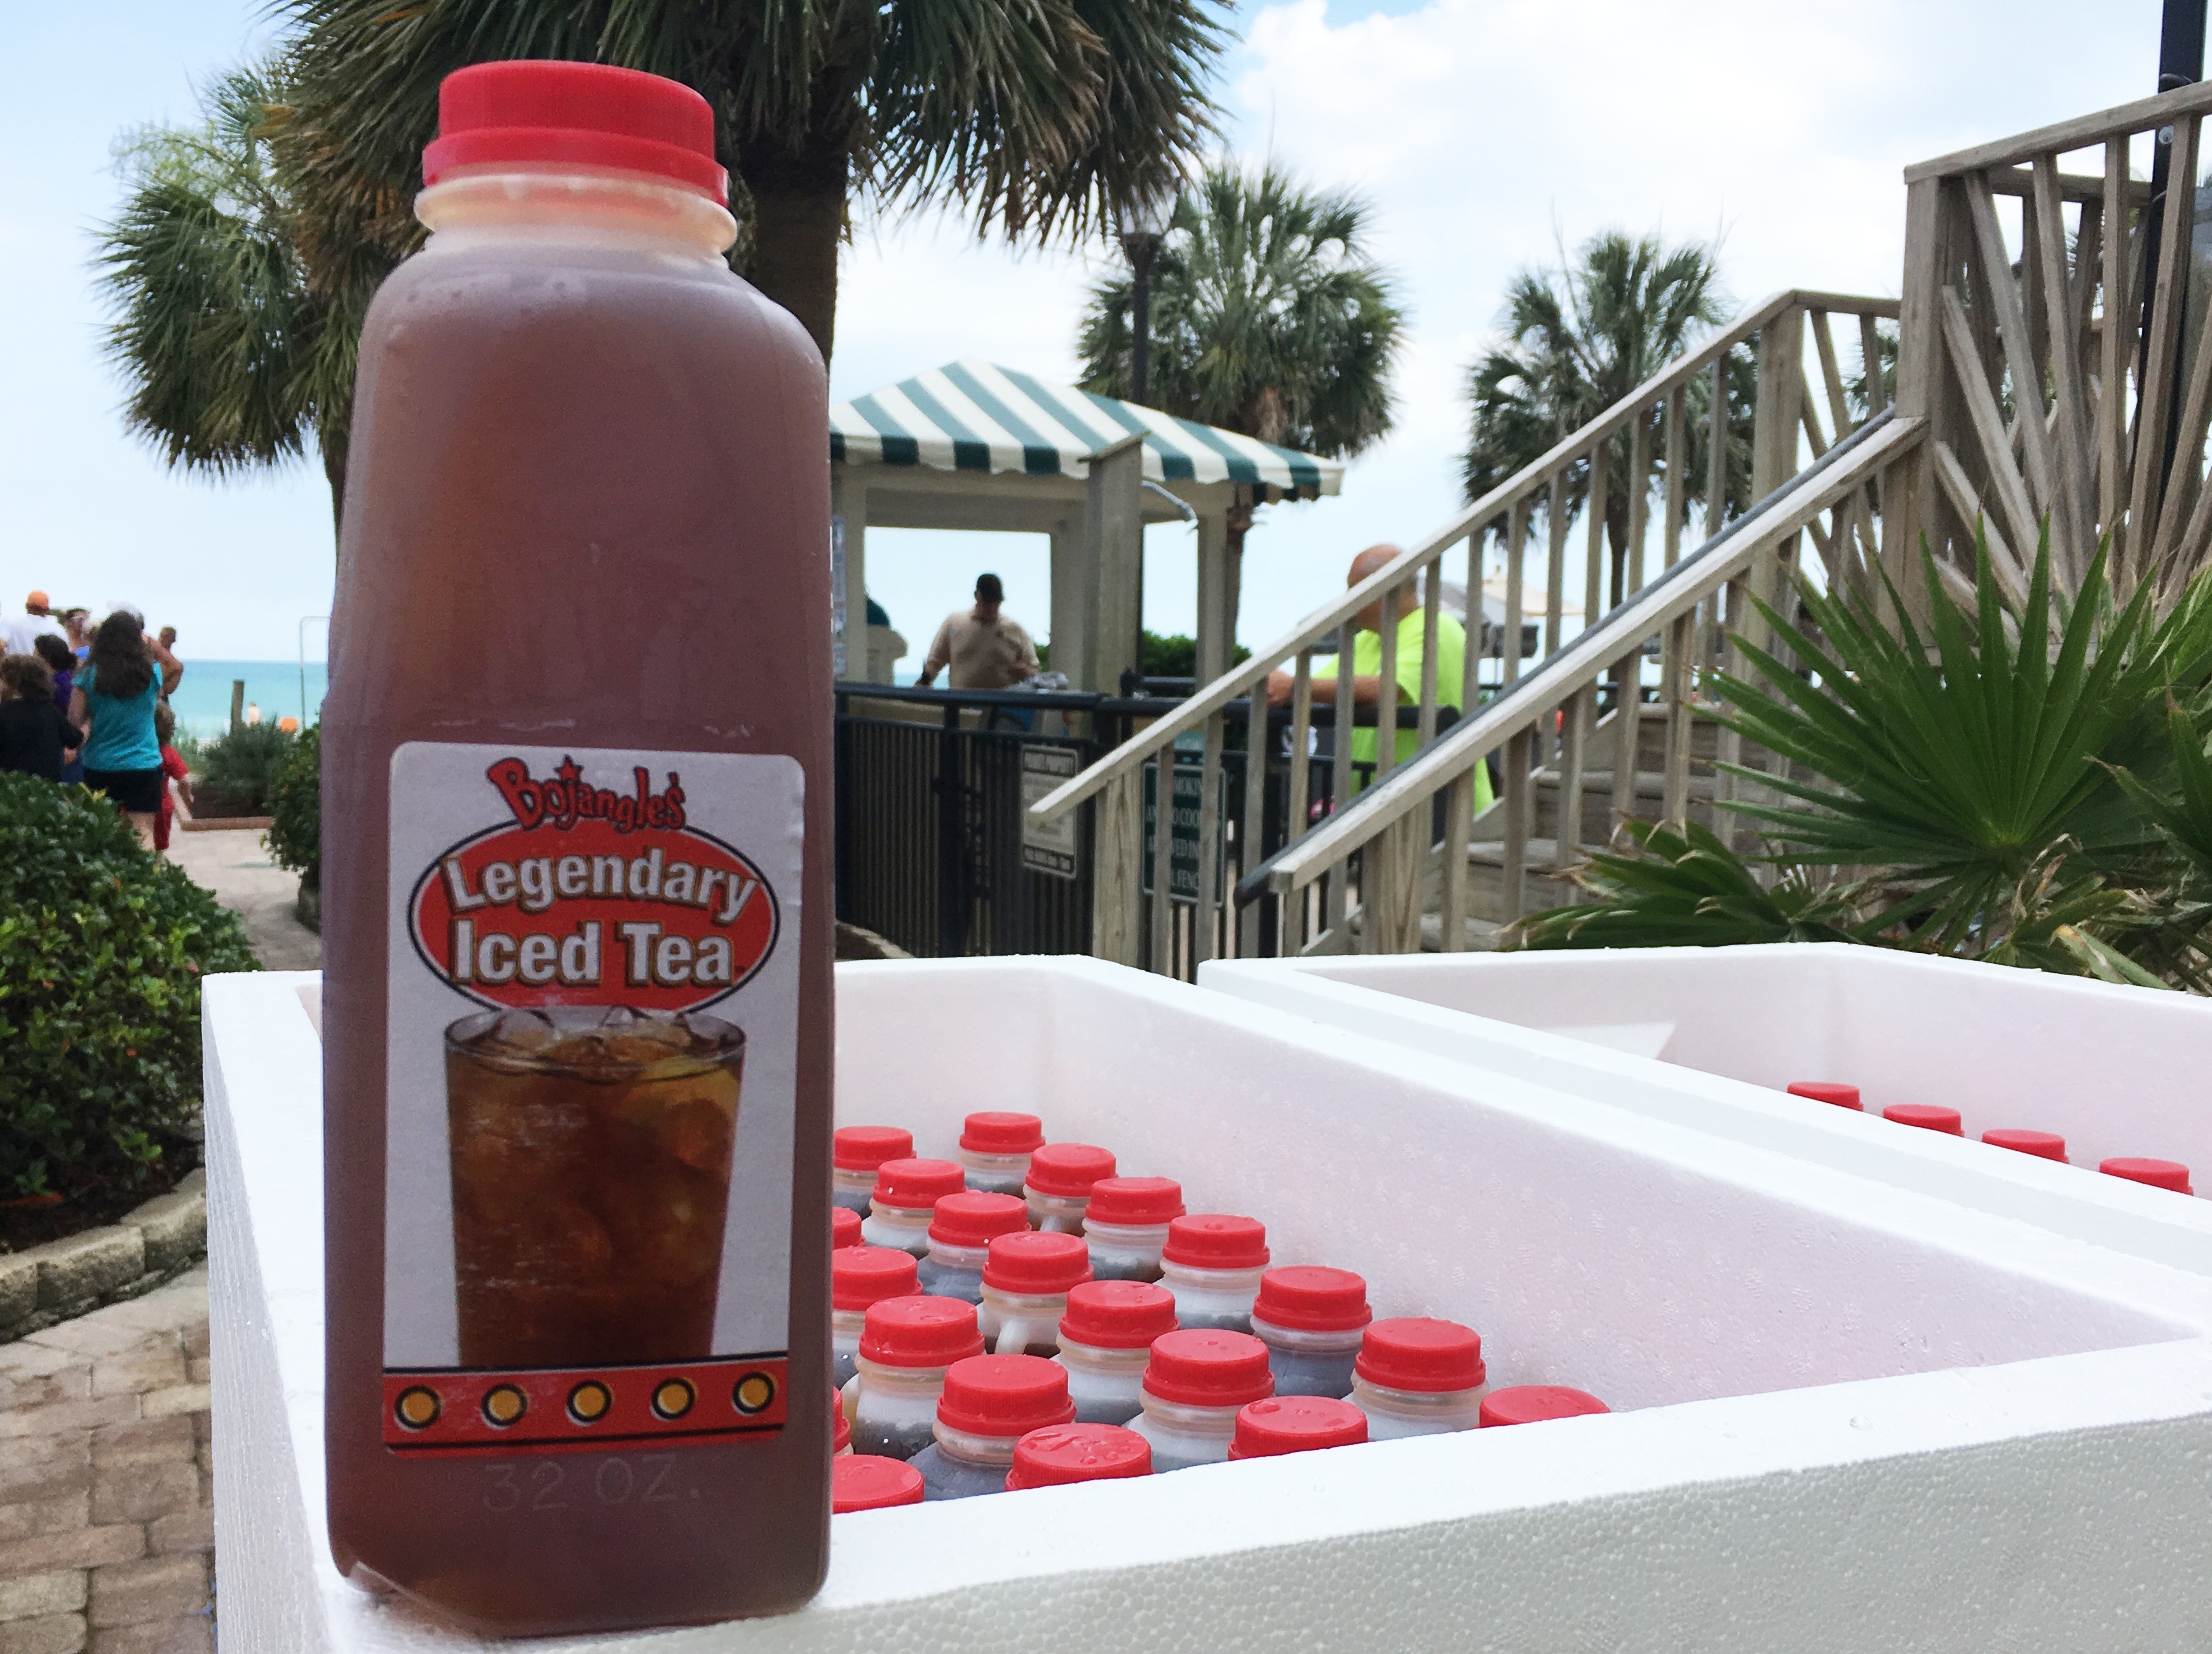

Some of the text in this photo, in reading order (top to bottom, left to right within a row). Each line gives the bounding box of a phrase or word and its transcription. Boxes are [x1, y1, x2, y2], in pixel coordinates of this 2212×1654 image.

[443, 847, 761, 926] Legendary
[450, 917, 735, 986] Iced Tea
[483, 1463, 569, 1512] 32
